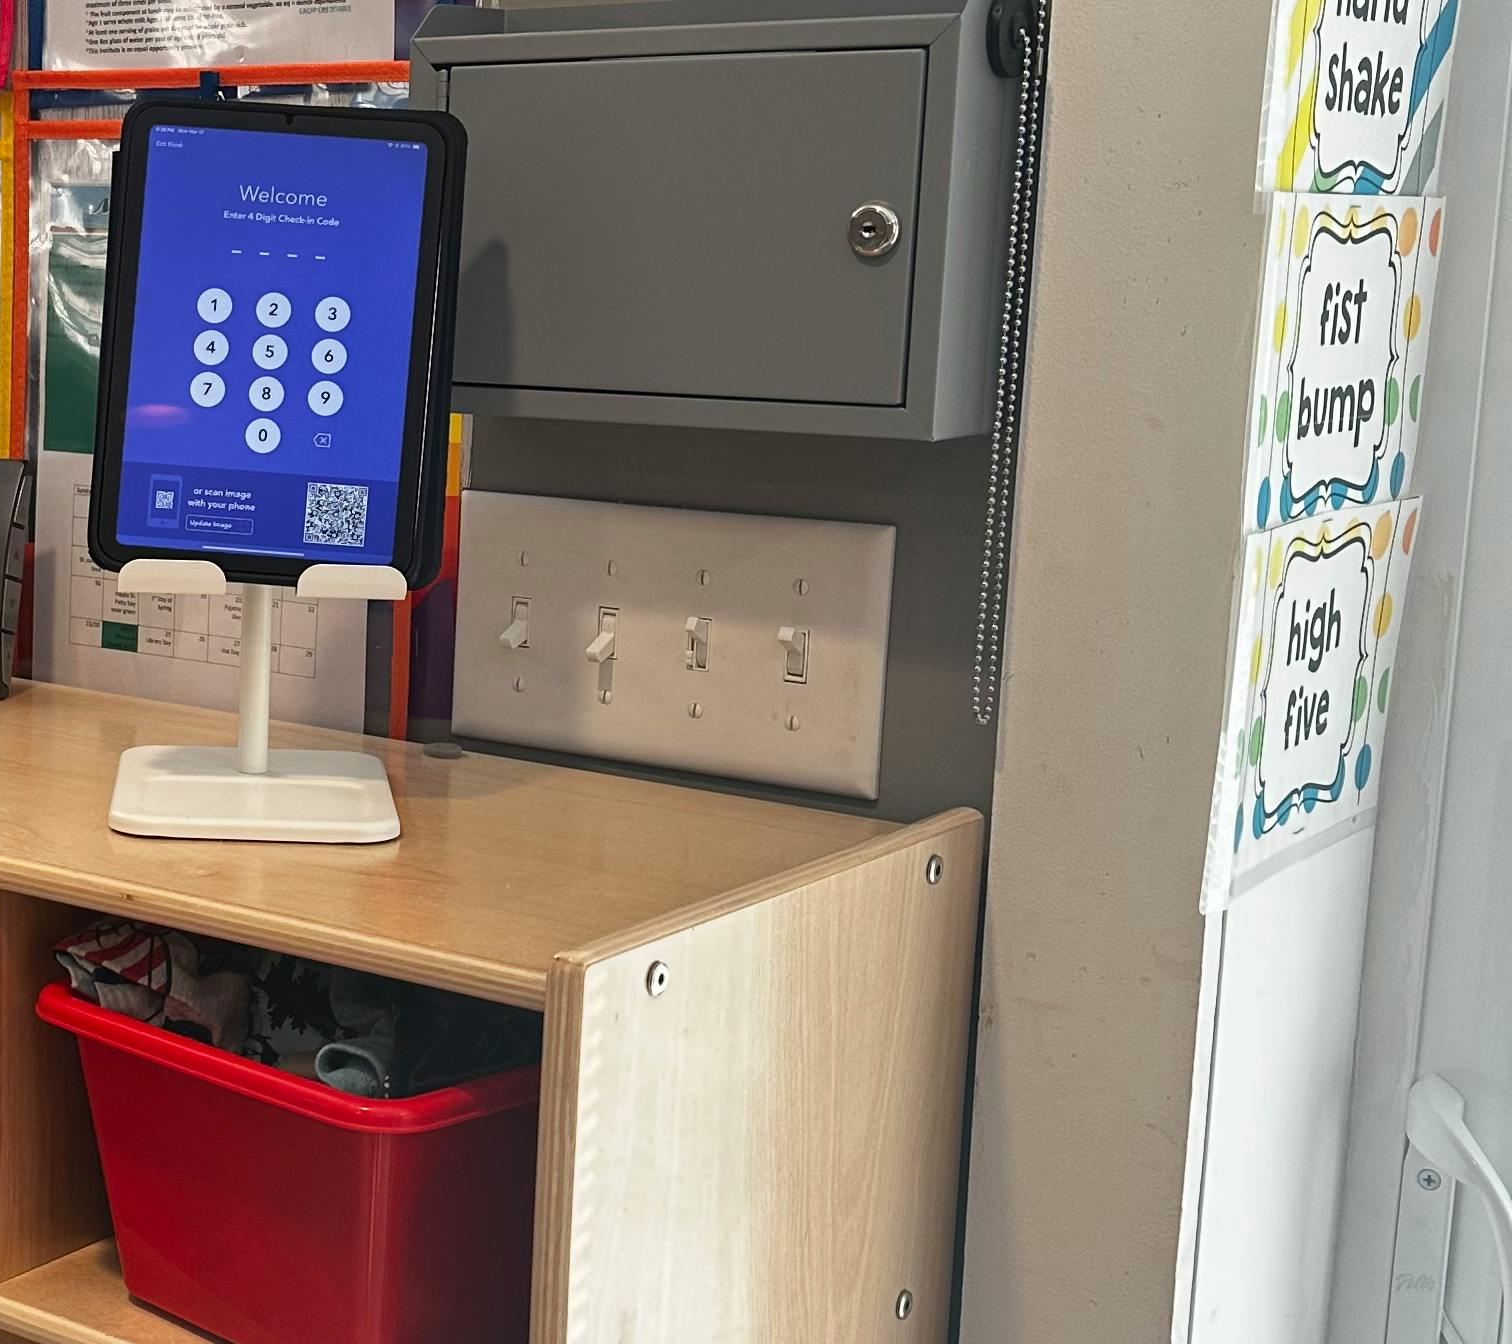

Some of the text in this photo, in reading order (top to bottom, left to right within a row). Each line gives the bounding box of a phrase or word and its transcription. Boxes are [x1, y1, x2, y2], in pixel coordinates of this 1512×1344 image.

[1324, 41, 1405, 118] shake
[239, 184, 328, 207] Welcome
[223, 209, 340, 227] Enter 4 Digit Check-in Code
[211, 299, 338, 322] 1 2 3
[1319, 278, 1368, 346] fist
[205, 341, 334, 363] 4 5 6
[203, 382, 331, 406] 7 8 9
[1296, 376, 1376, 448] bump
[258, 428, 268, 443] 0
[188, 499, 256, 512] with your phone
[204, 489, 223, 497] scan
[224, 489, 252, 500] image
[1285, 588, 1343, 674] high
[1284, 685, 1331, 751] five
